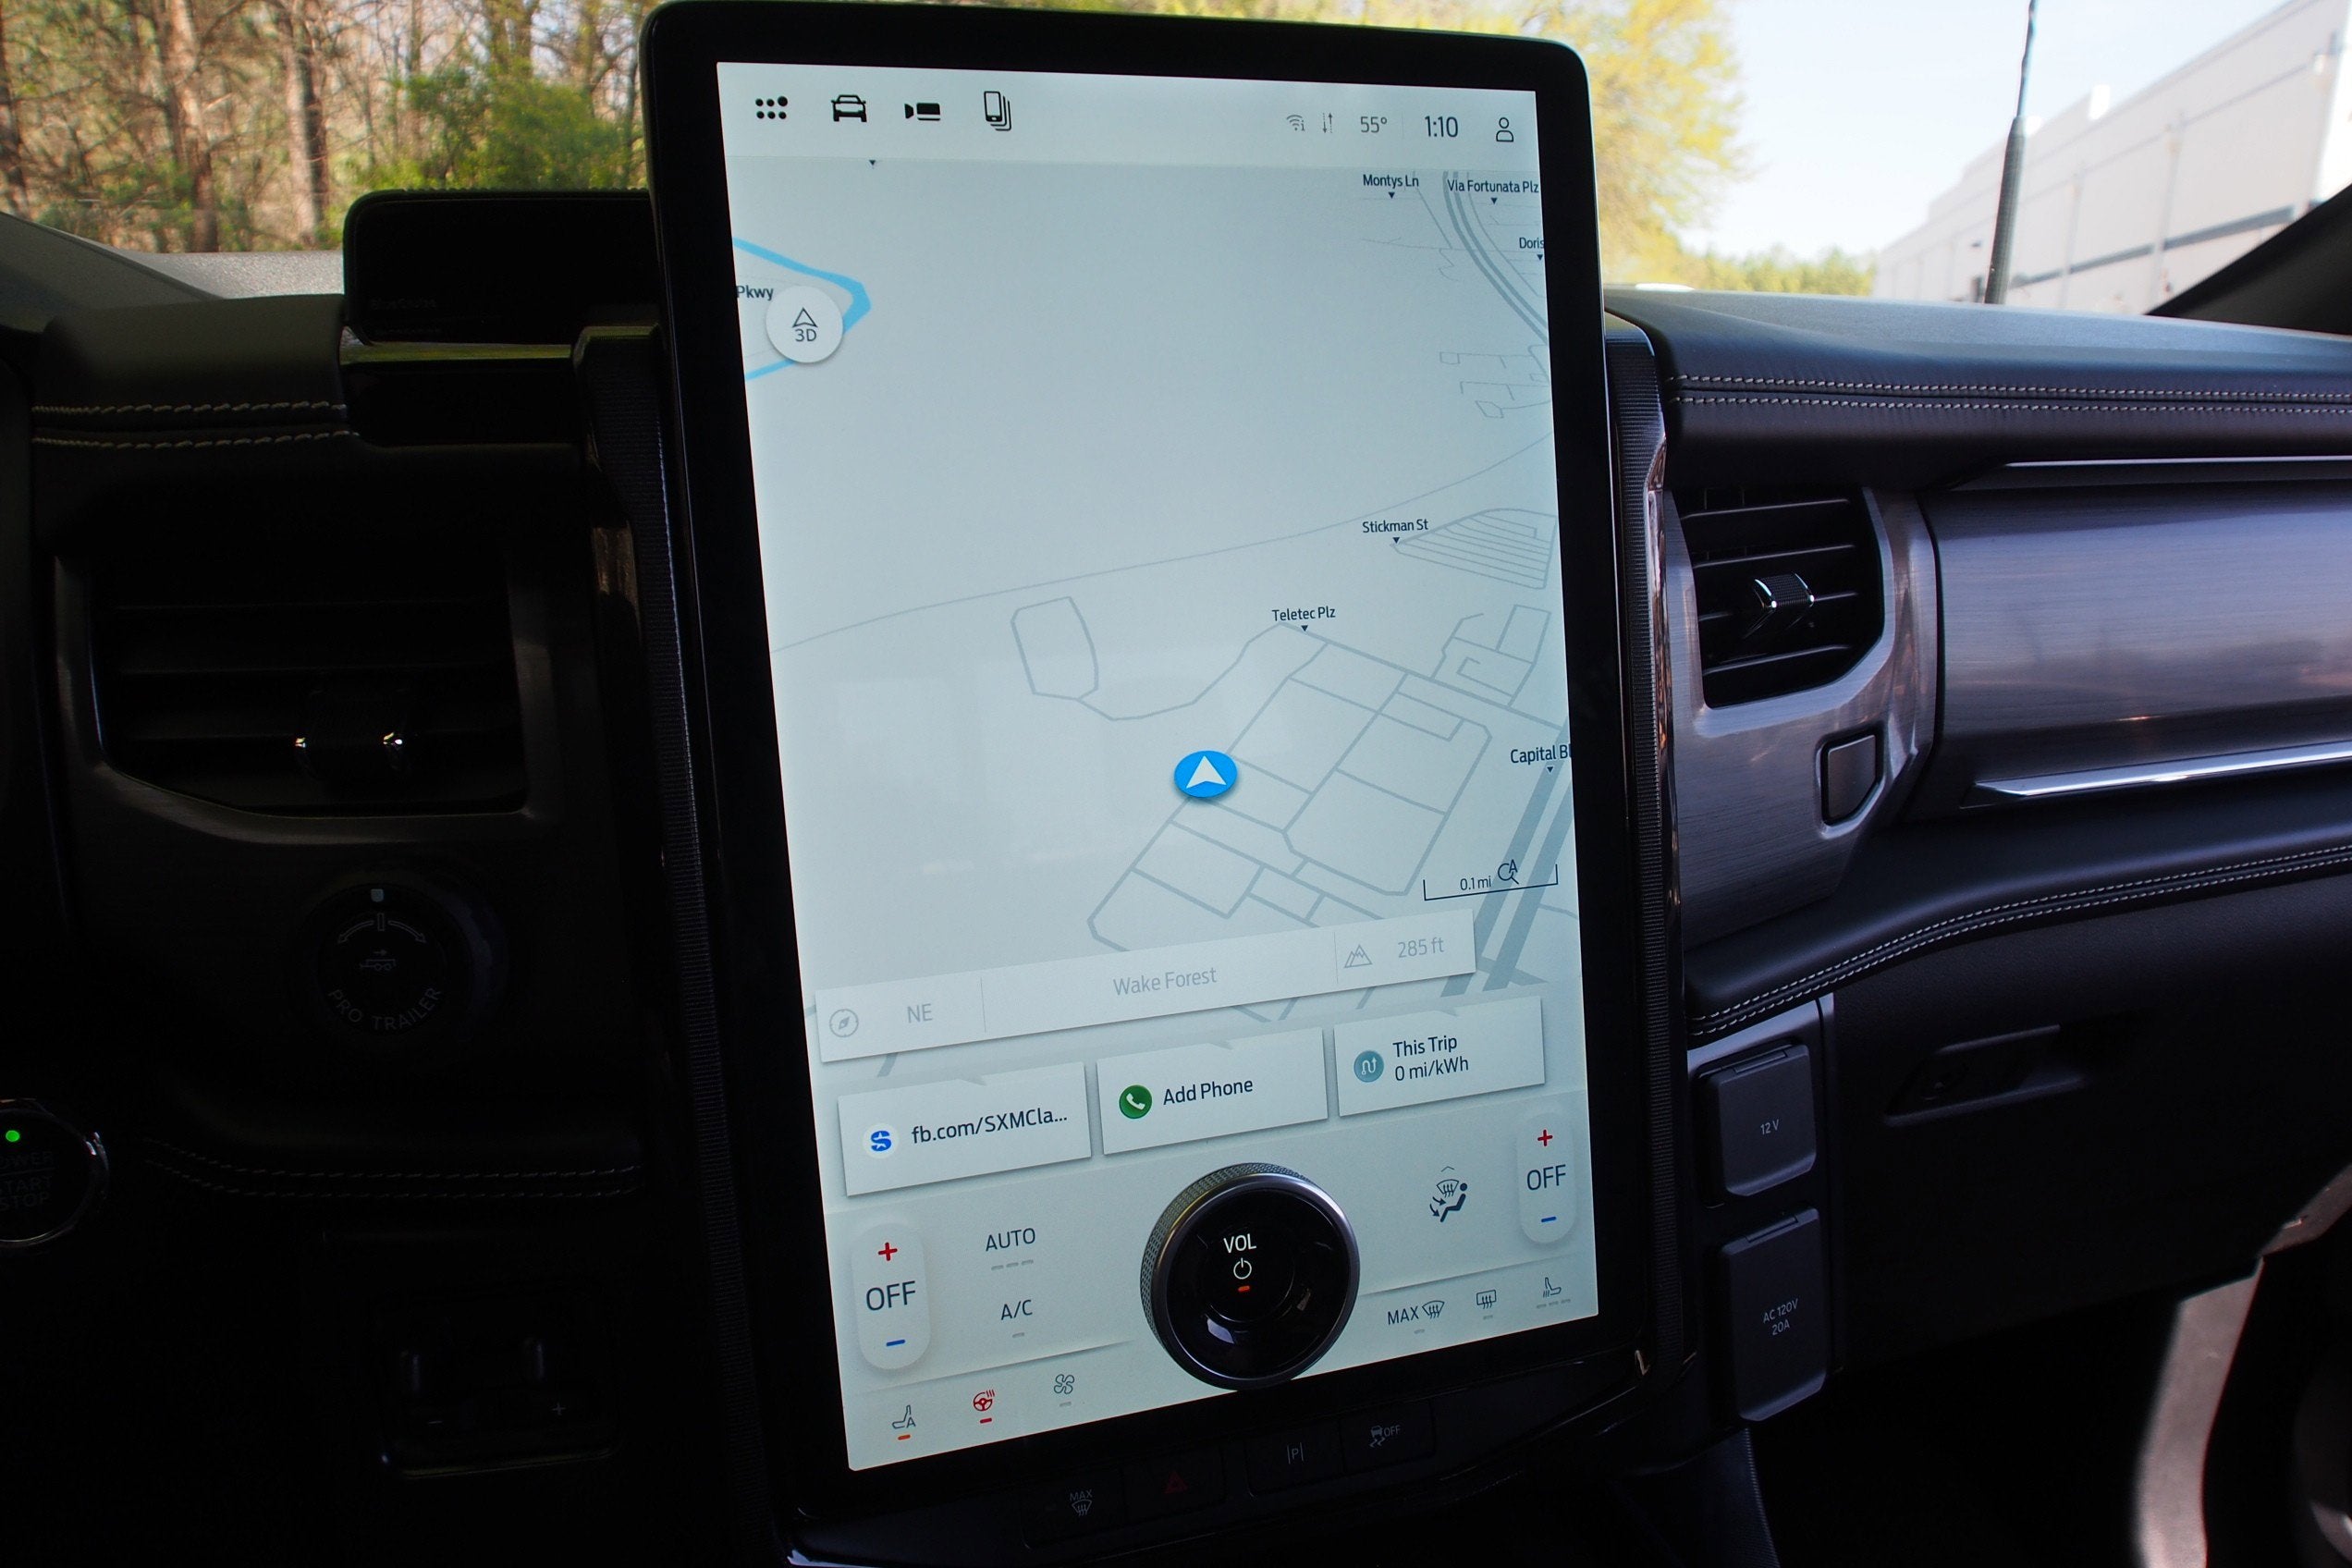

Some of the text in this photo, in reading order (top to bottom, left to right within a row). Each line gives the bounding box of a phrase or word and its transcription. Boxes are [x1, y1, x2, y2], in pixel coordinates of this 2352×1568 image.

[1360, 116, 1388, 134] 55°
[1424, 116, 1459, 138] 1:10
[1363, 174, 1419, 190] Montys Ln
[1447, 178, 1539, 193] Via Fortunata Plz
[1519, 237, 1544, 249] Doris
[736, 284, 774, 301] Pkwy
[794, 328, 817, 342] 3D
[1362, 519, 1429, 534] Stickman St
[1271, 606, 1336, 622] Teletec Plz
[1510, 745, 1557, 766] Capital
[907, 936, 1445, 1023] NE Wake Forest 285 ft
[327, 987, 442, 1030] PRO TRAILER
[1392, 1035, 1458, 1058] This Trip
[1395, 1056, 1470, 1082] 0 mi/kWh
[1163, 1079, 1254, 1107] Add Phone
[1759, 1119, 1780, 1136] 12 V
[1526, 1164, 1566, 1191] OFF
[985, 1227, 1036, 1252] AUTO
[1223, 1232, 1256, 1254] VOL
[865, 1280, 916, 1311] OFF
[999, 1299, 1034, 1321] A/C
[1388, 1305, 1419, 1326] MAX
[1762, 1298, 1799, 1323] AC 120V
[1771, 1320, 1791, 1336] 20A
[1383, 1424, 1402, 1438] OFF
[1069, 1488, 1093, 1502] MAX
